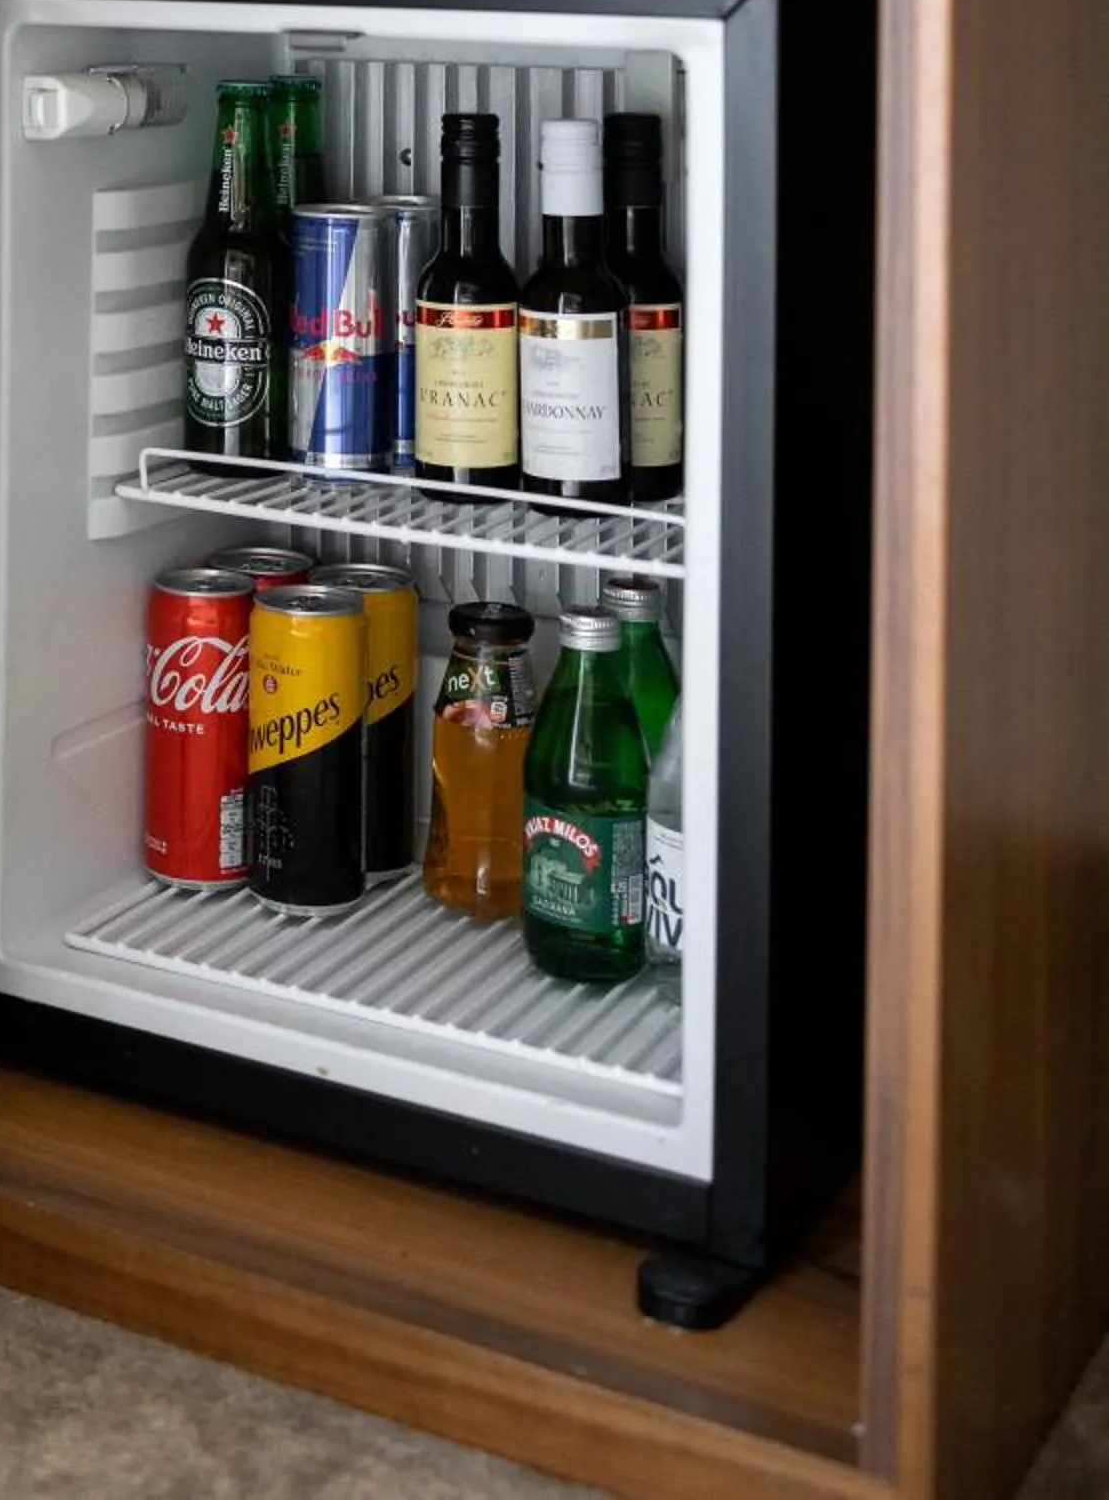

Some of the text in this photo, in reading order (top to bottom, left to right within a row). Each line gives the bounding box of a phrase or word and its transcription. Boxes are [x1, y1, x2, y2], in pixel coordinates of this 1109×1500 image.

[218, 149, 232, 212] Heineken
[521, 400, 606, 420] ARDONNAY
[163, 718, 204, 735] TASTE
